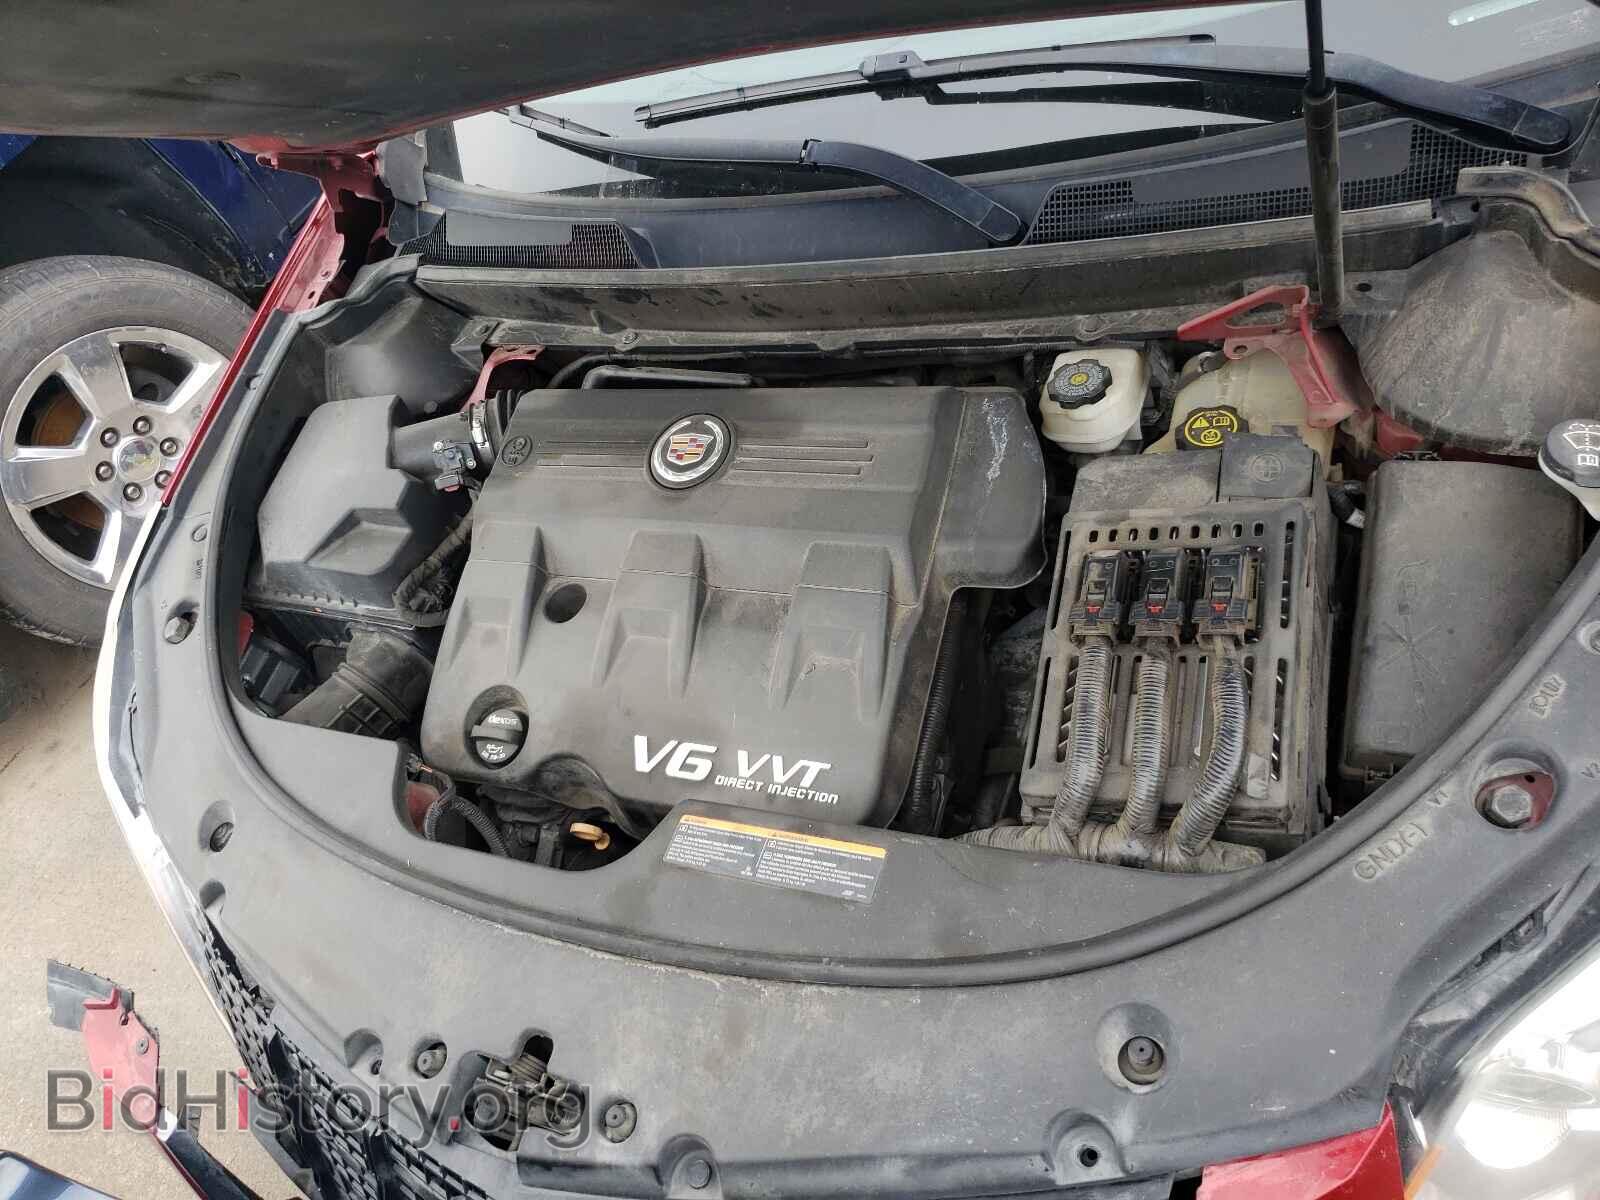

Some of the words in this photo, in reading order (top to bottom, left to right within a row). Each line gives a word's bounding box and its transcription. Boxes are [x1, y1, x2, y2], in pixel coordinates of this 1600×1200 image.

[633, 734, 717, 781] V6
[737, 749, 832, 788] VVT
[714, 775, 763, 792] DIRECT
[767, 786, 839, 805] INJECTION
